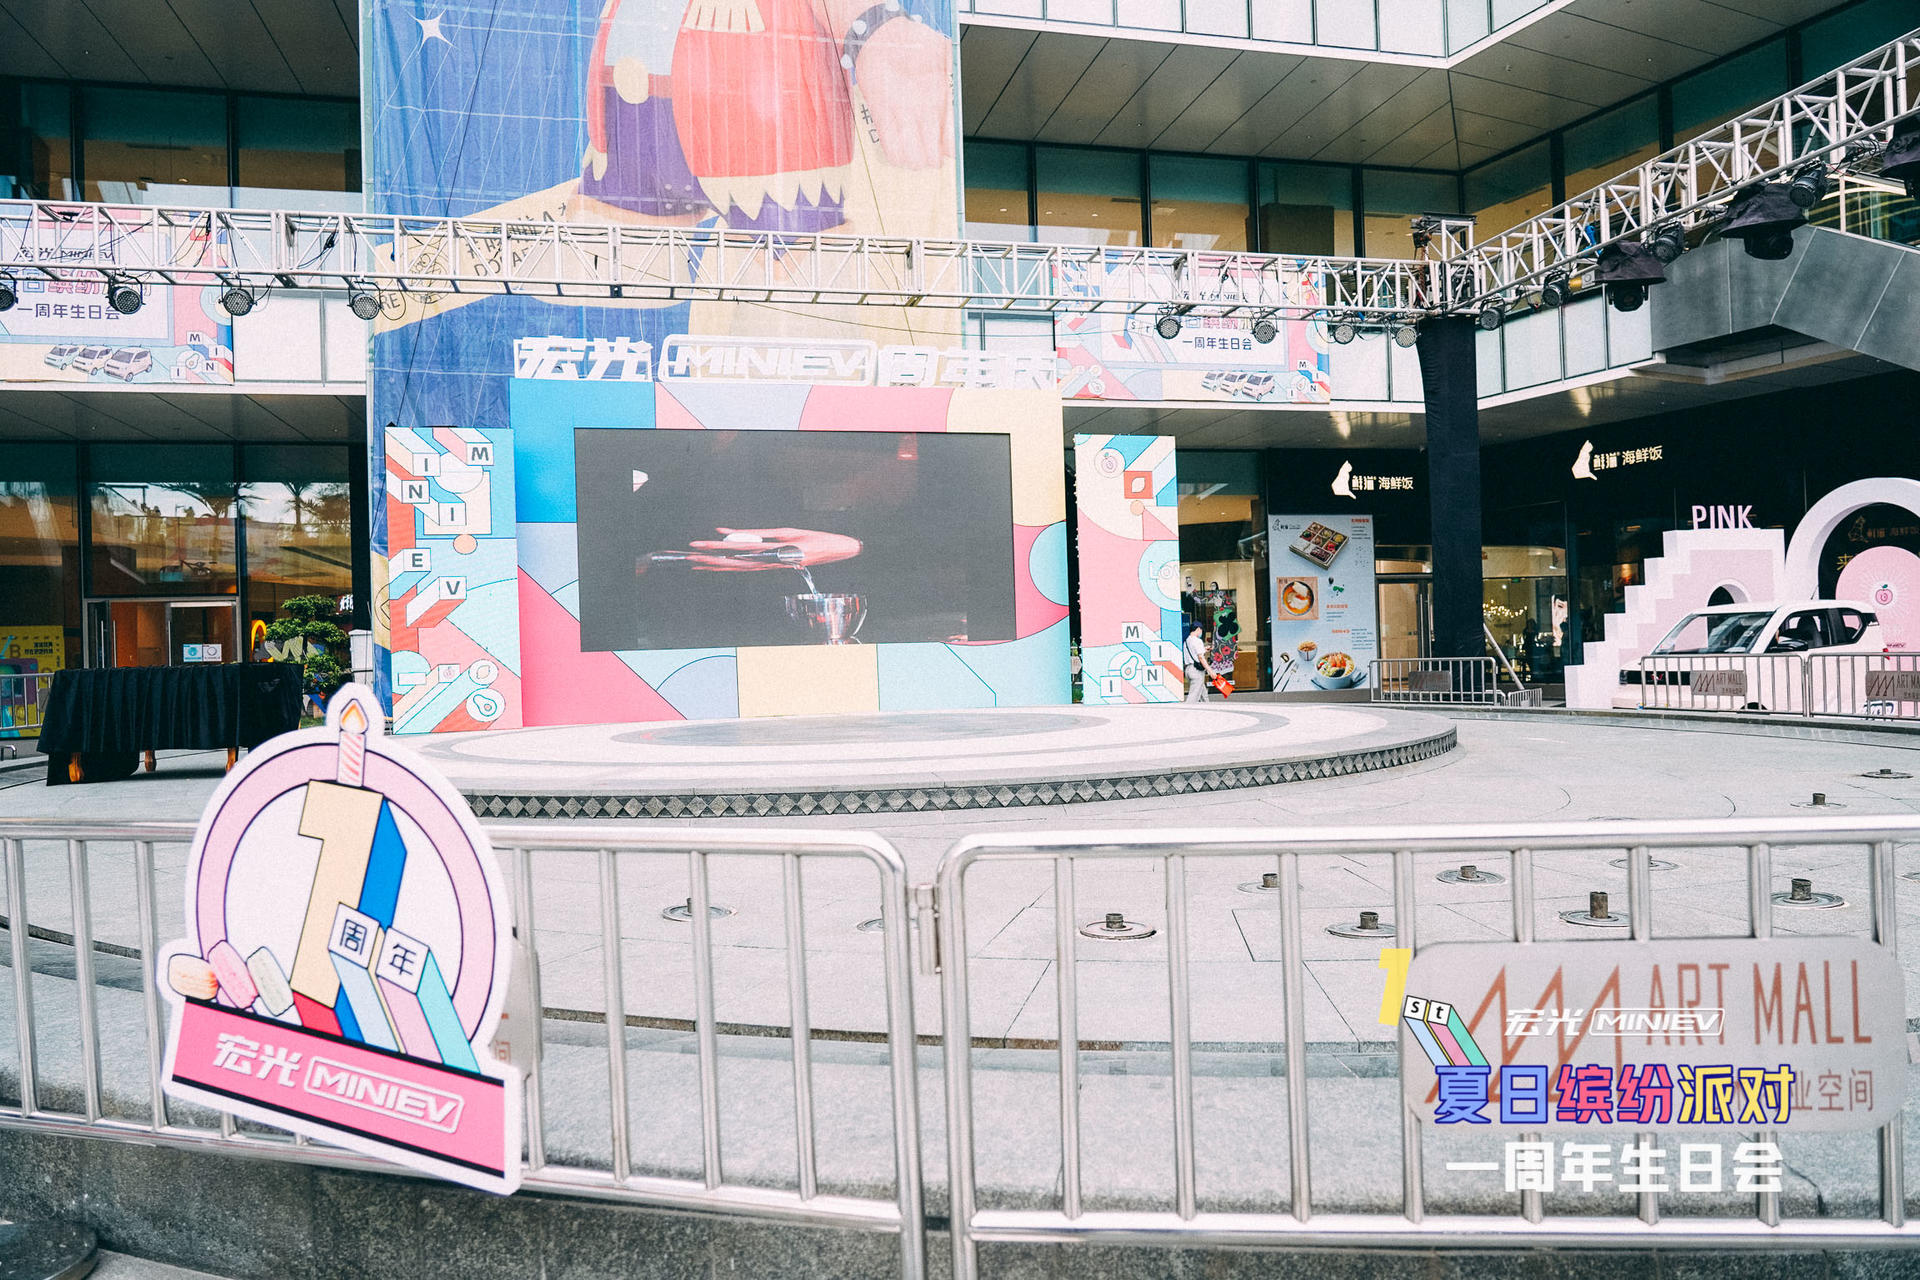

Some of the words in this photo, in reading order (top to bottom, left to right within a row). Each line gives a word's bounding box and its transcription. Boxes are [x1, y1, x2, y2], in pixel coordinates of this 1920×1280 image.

[17, 303, 119, 319] 一周年生日会
[514, 335, 653, 381] 宏光
[1182, 337, 1252, 351] 一周年生日会
[1691, 504, 1754, 530] PINK
[1646, 963, 1730, 1046] ART
[1753, 960, 1872, 1045] MALL
[212, 1032, 303, 1088] 宏光
[311, 1063, 457, 1126] MINIEV
